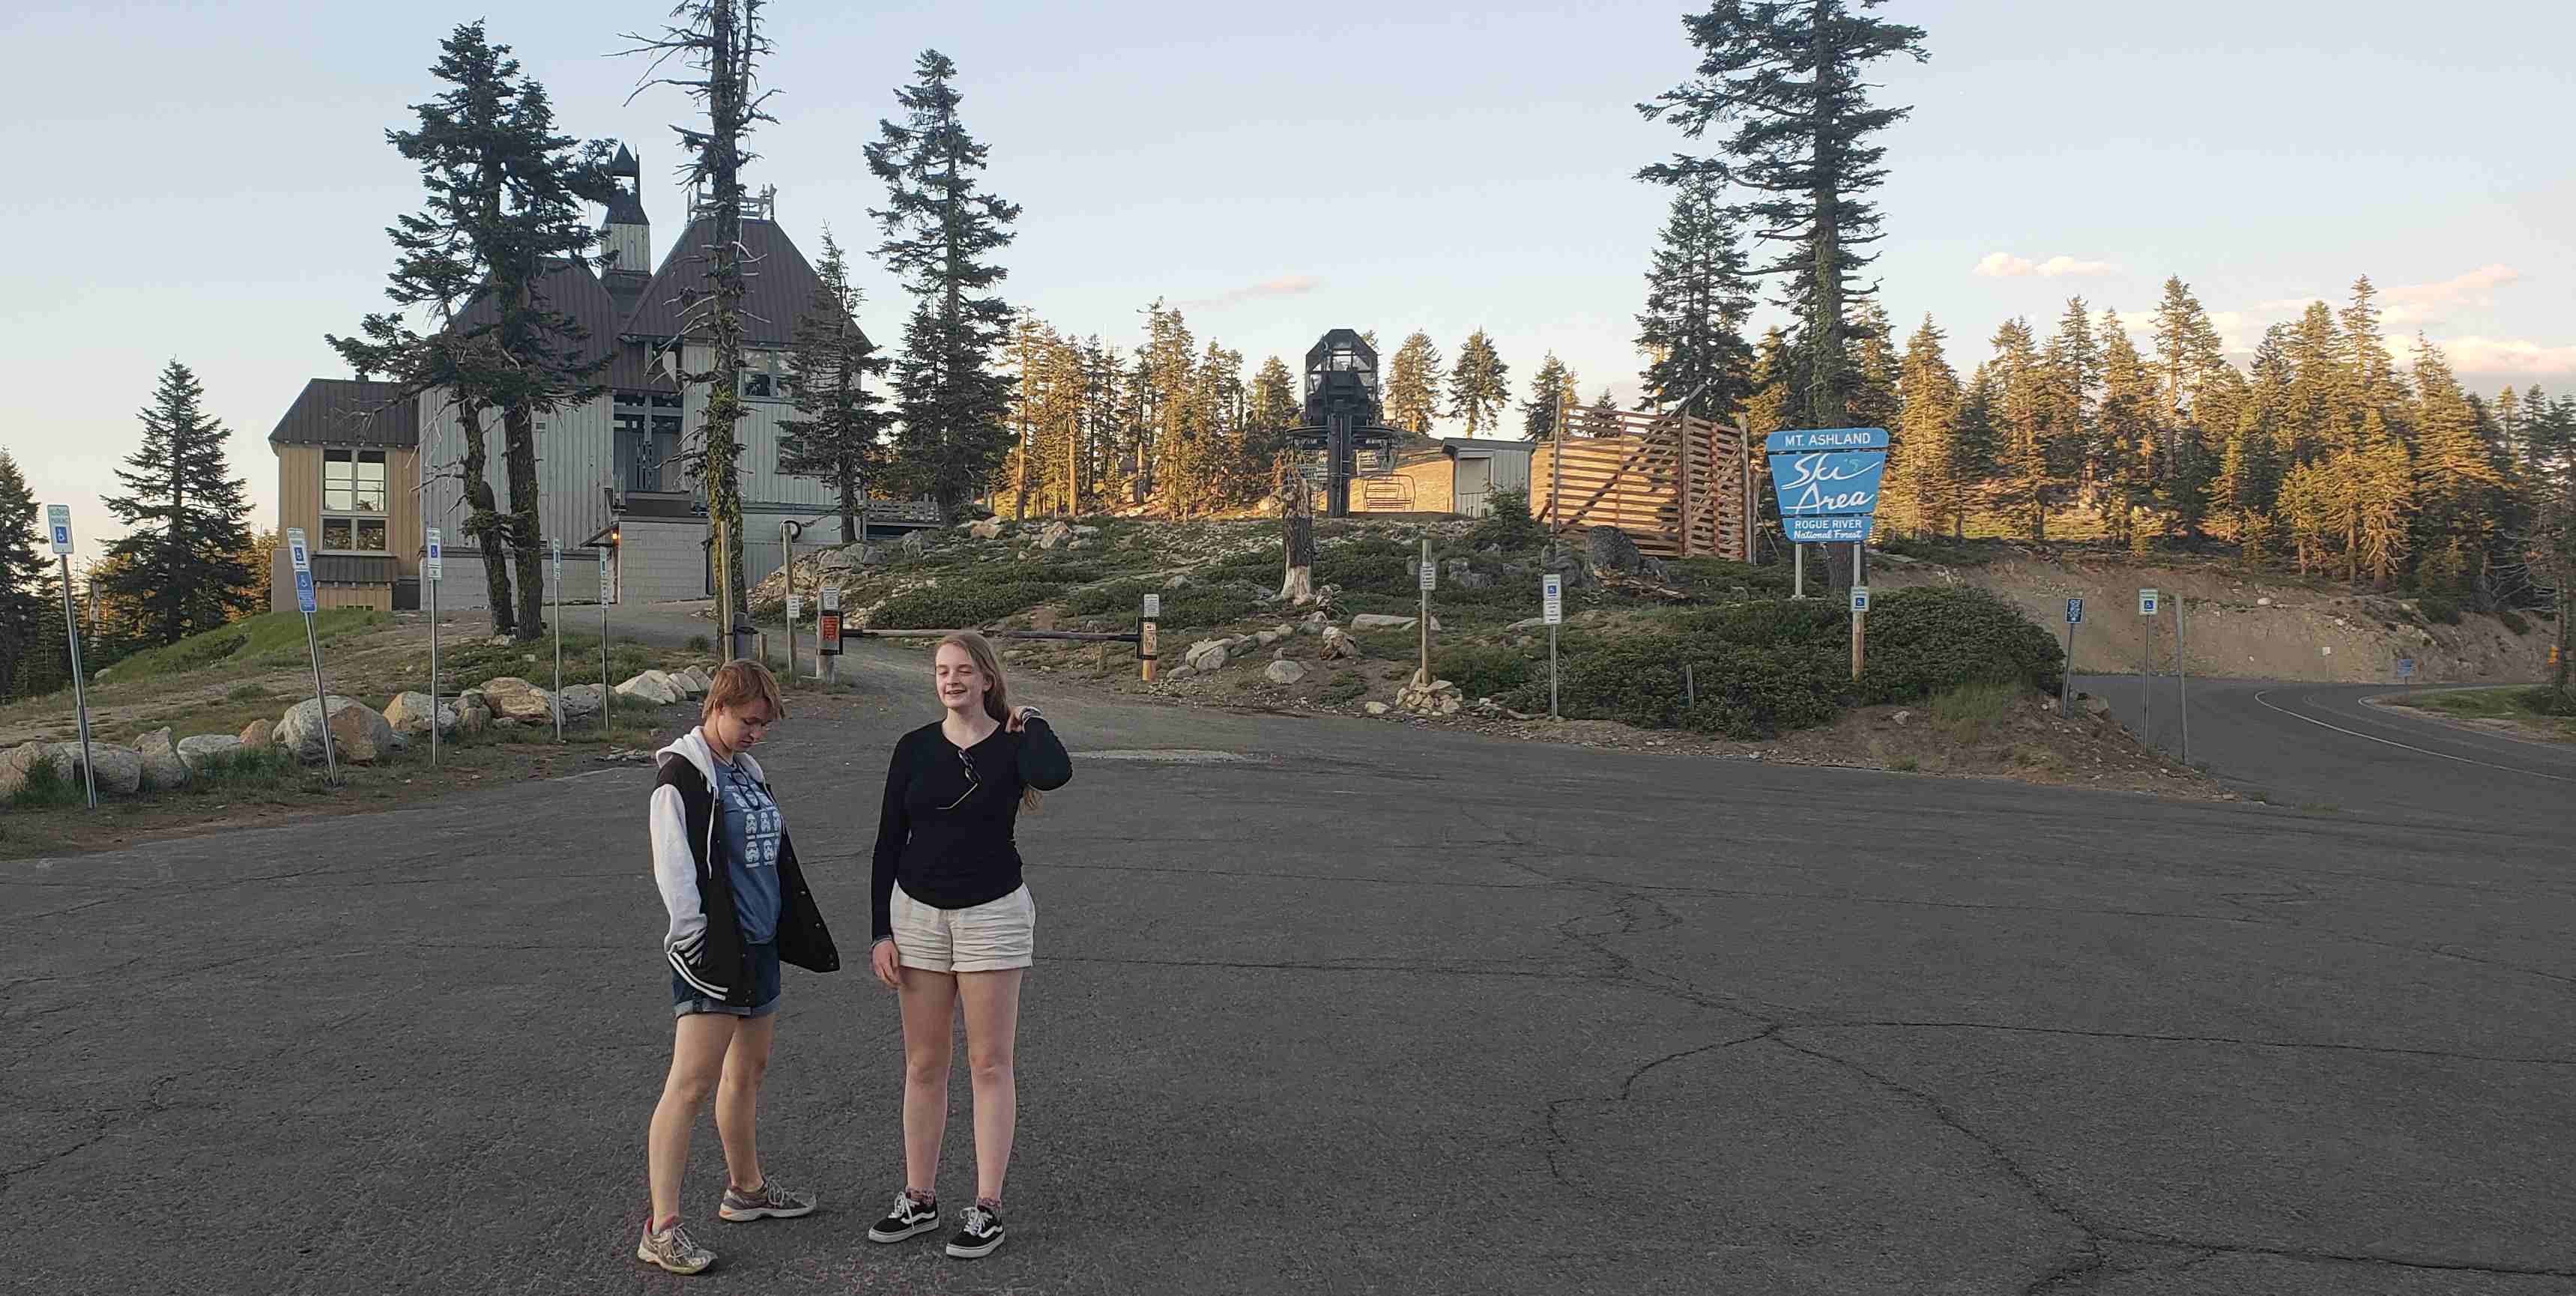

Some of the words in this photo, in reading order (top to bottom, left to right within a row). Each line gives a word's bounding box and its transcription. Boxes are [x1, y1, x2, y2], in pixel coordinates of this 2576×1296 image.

[1785, 434, 1804, 447] MT.
[1809, 432, 1871, 446] ASHLAND
[1781, 452, 1881, 490] Ski
[1784, 481, 1875, 515] Area
[1795, 519, 1829, 529] ROGUE
[1832, 518, 1862, 529] RIVER
[1794, 529, 1833, 539] National
[1833, 529, 1863, 539] Forest
